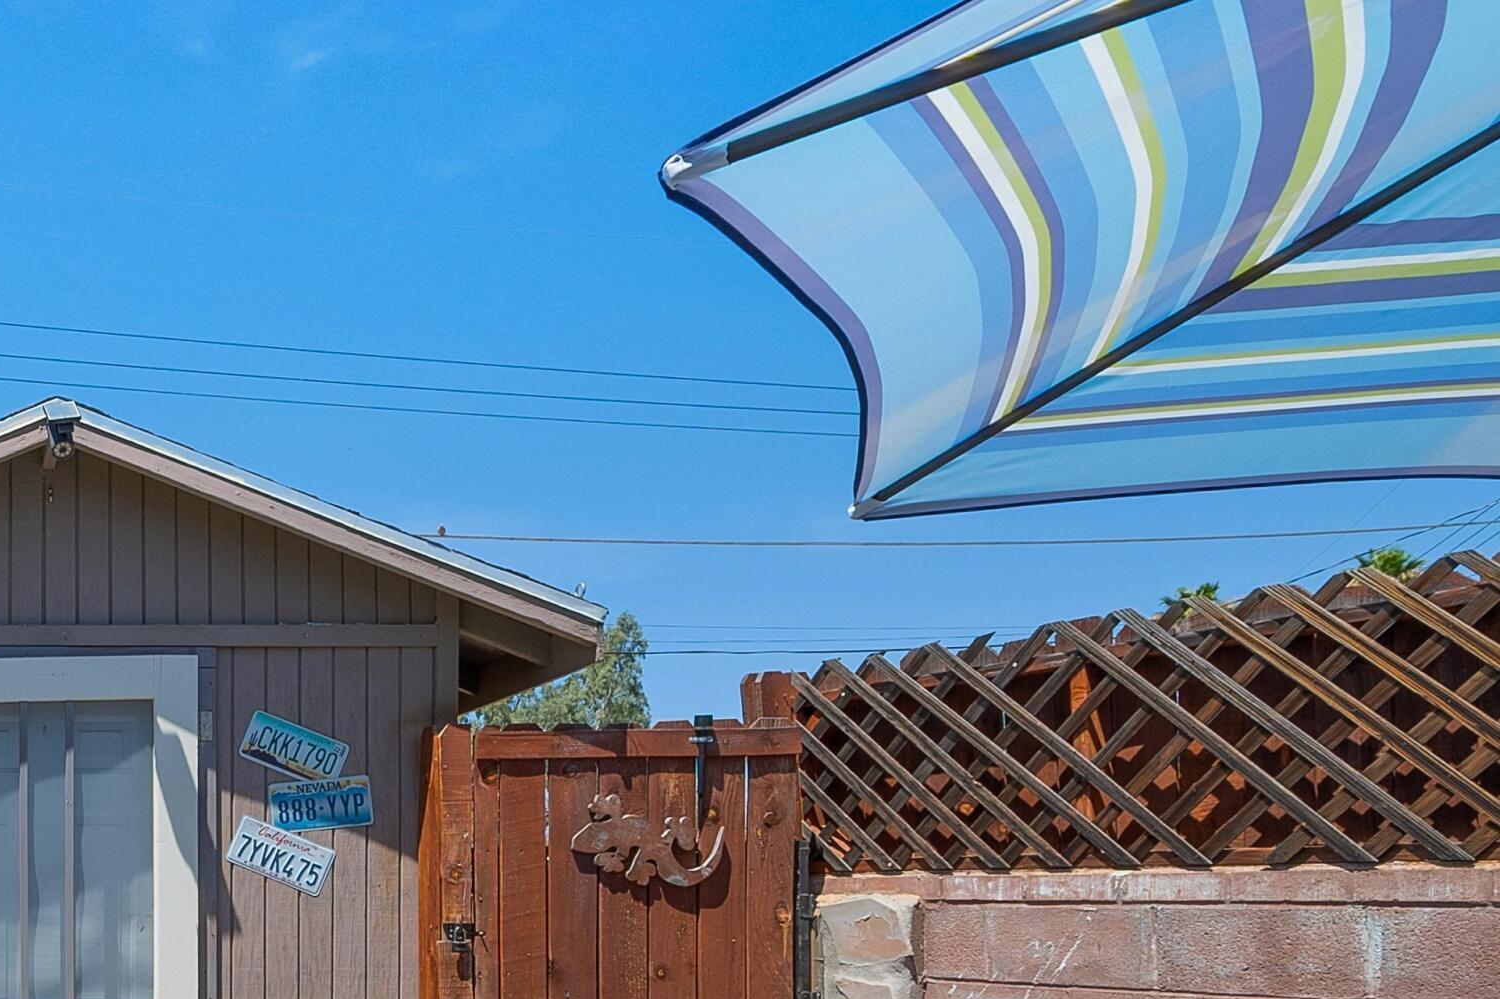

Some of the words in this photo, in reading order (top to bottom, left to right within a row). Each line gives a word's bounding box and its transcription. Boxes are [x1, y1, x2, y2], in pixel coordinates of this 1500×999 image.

[257, 726, 338, 775] CKK1790
[295, 781, 342, 794] NEVADA
[258, 825, 311, 852] California
[237, 833, 323, 887] 7YVK475
